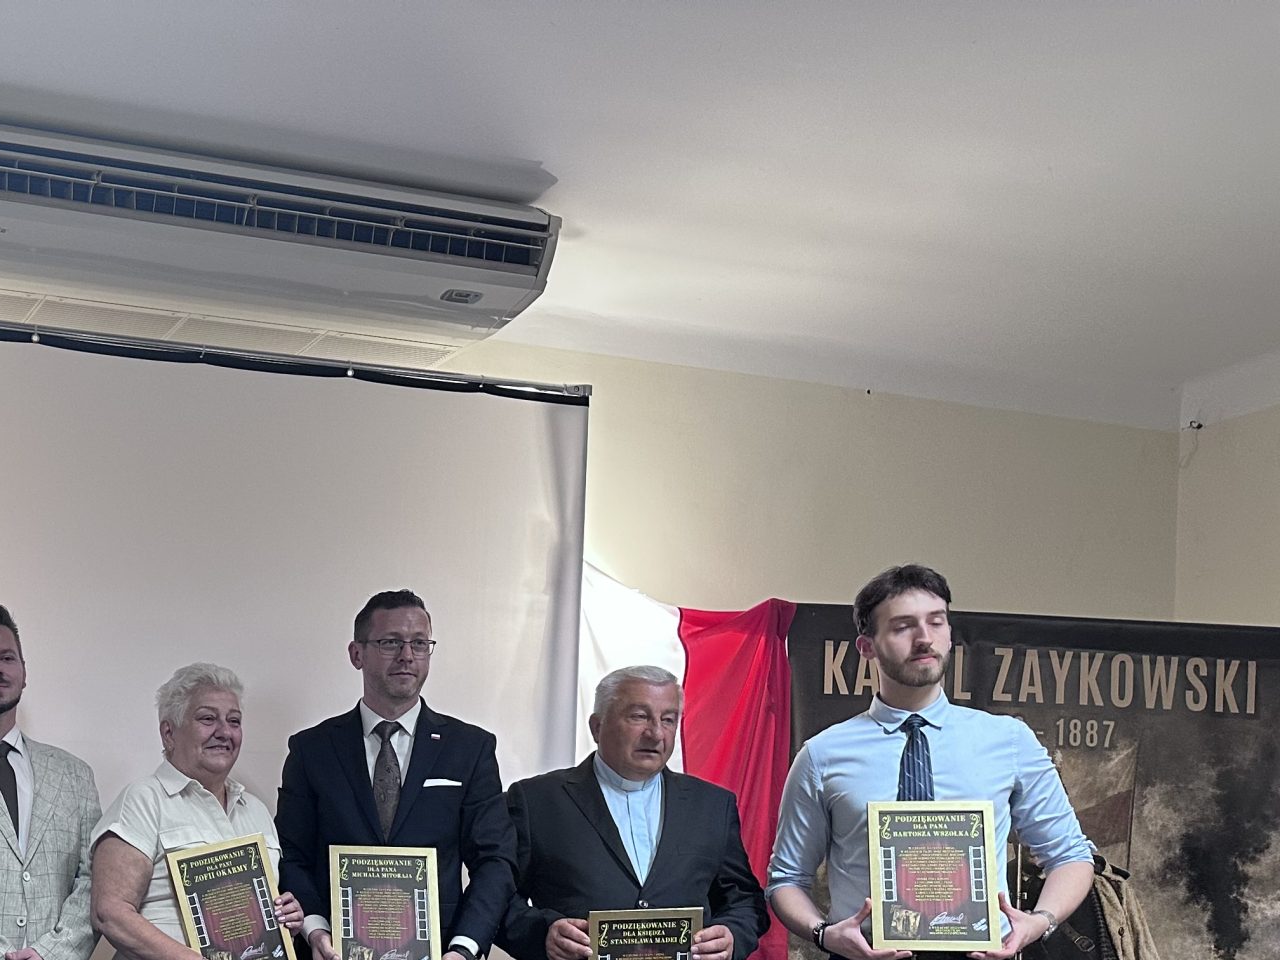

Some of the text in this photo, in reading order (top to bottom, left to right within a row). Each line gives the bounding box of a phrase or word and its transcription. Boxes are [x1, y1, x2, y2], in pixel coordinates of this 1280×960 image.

[823, 640, 1257, 714] KAL ZAYKOWSKI
[1056, 718, 1115, 748] 1887
[895, 815, 966, 823] PODZIĘKOWANIE
[189, 849, 245, 868] PODZIĘKOWANIE
[351, 858, 413, 867] PODZIĘKOWANIE
[193, 864, 248, 883] ZOFII OKARMY
[612, 921, 677, 931] PODZIĘKOWANIE
